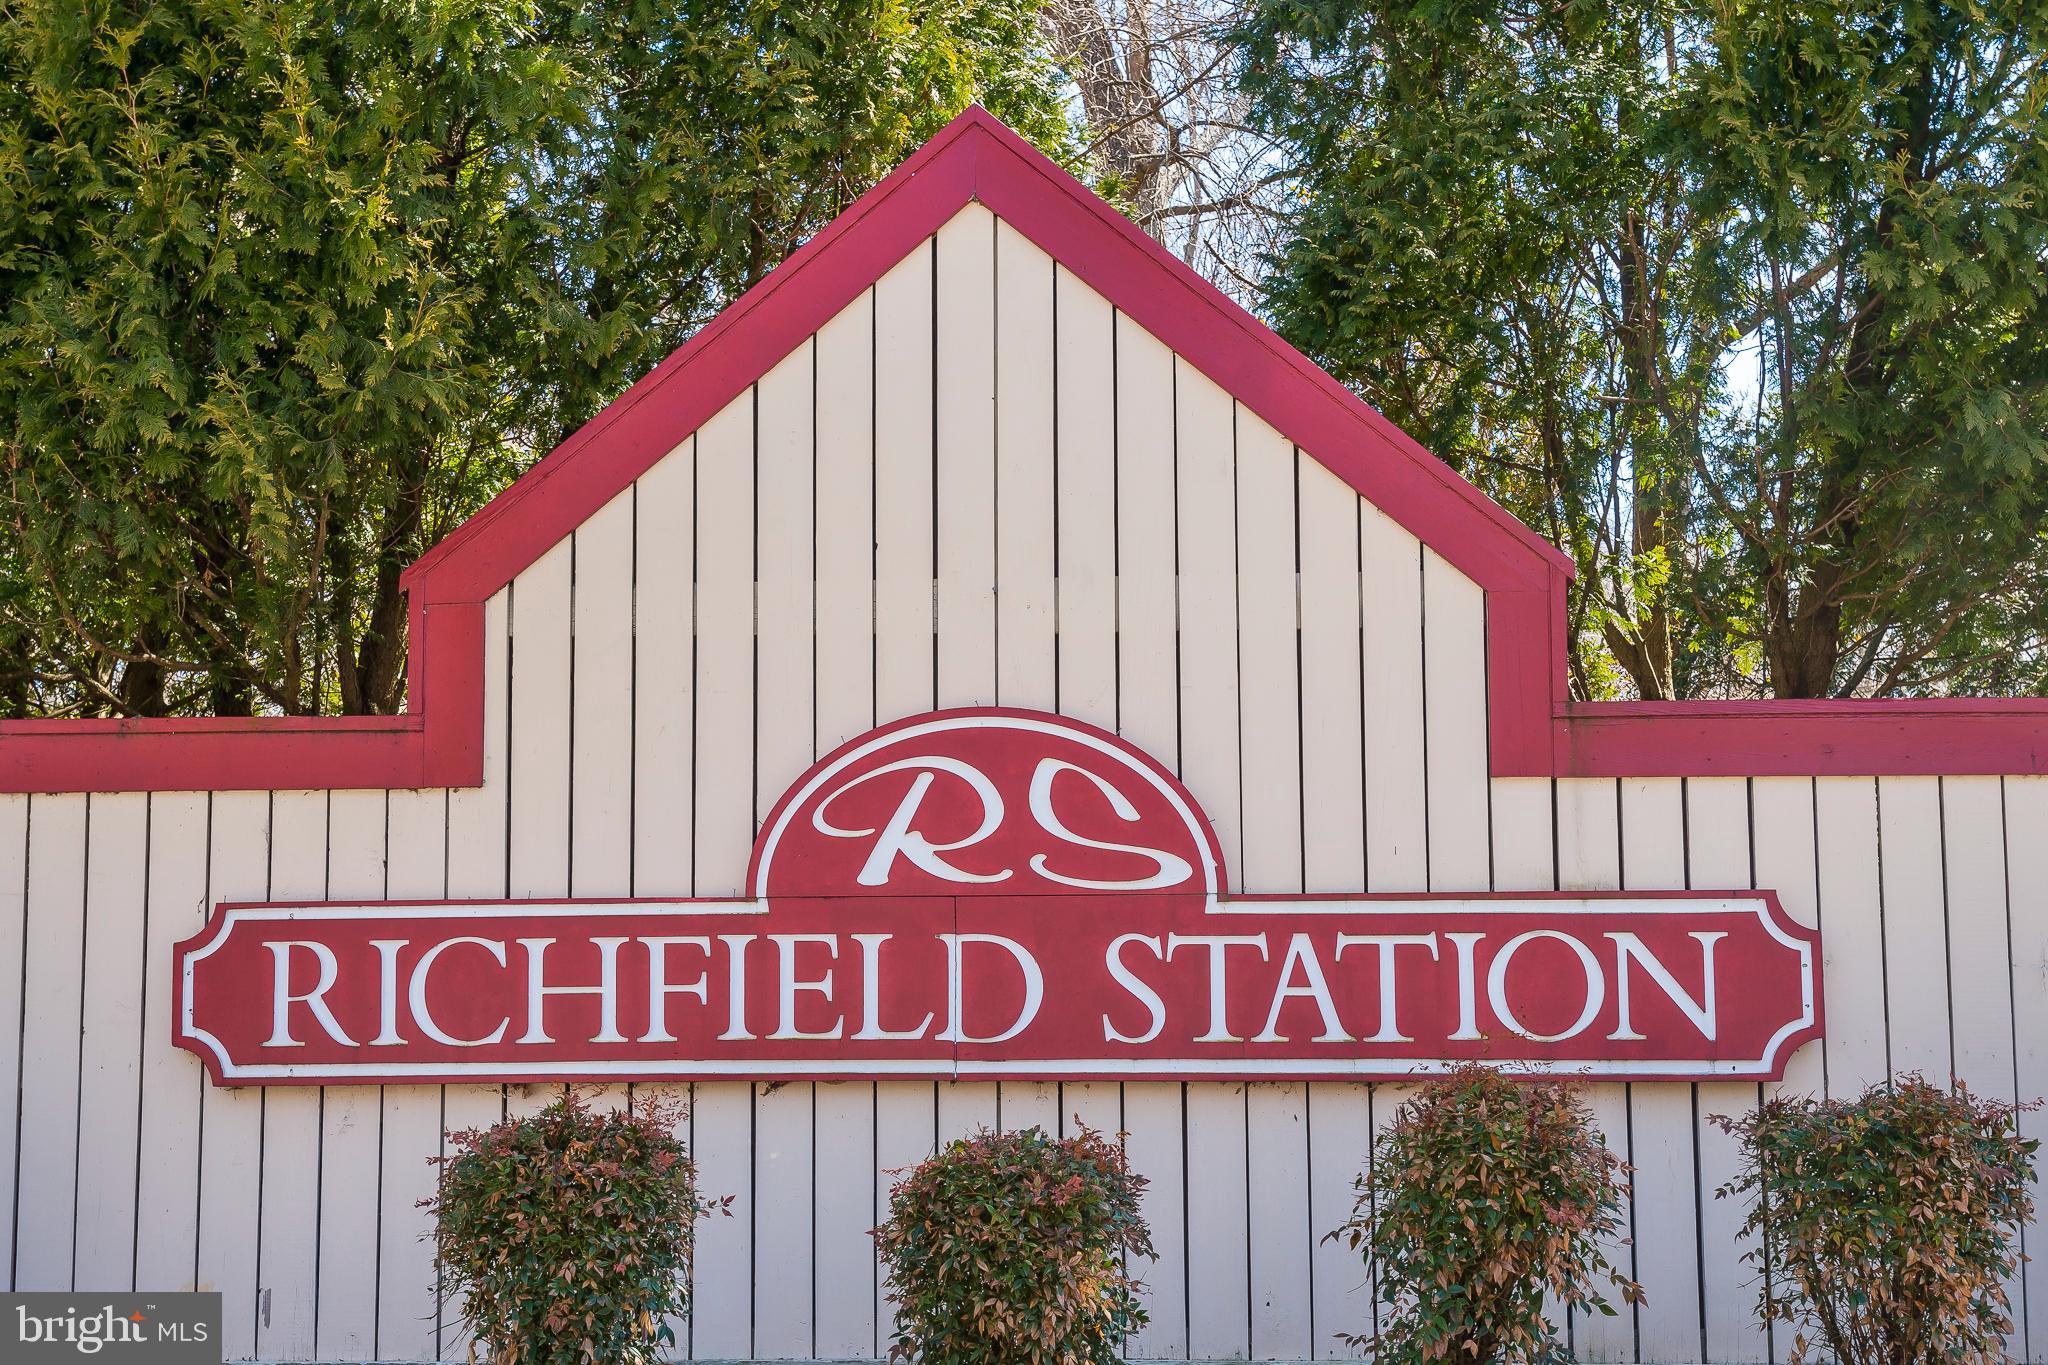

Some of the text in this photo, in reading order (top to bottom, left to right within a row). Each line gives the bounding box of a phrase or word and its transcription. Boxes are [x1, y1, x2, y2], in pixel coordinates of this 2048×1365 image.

[812, 755, 1194, 890] RS
[261, 930, 1729, 1047] RICHFIELD STATION
